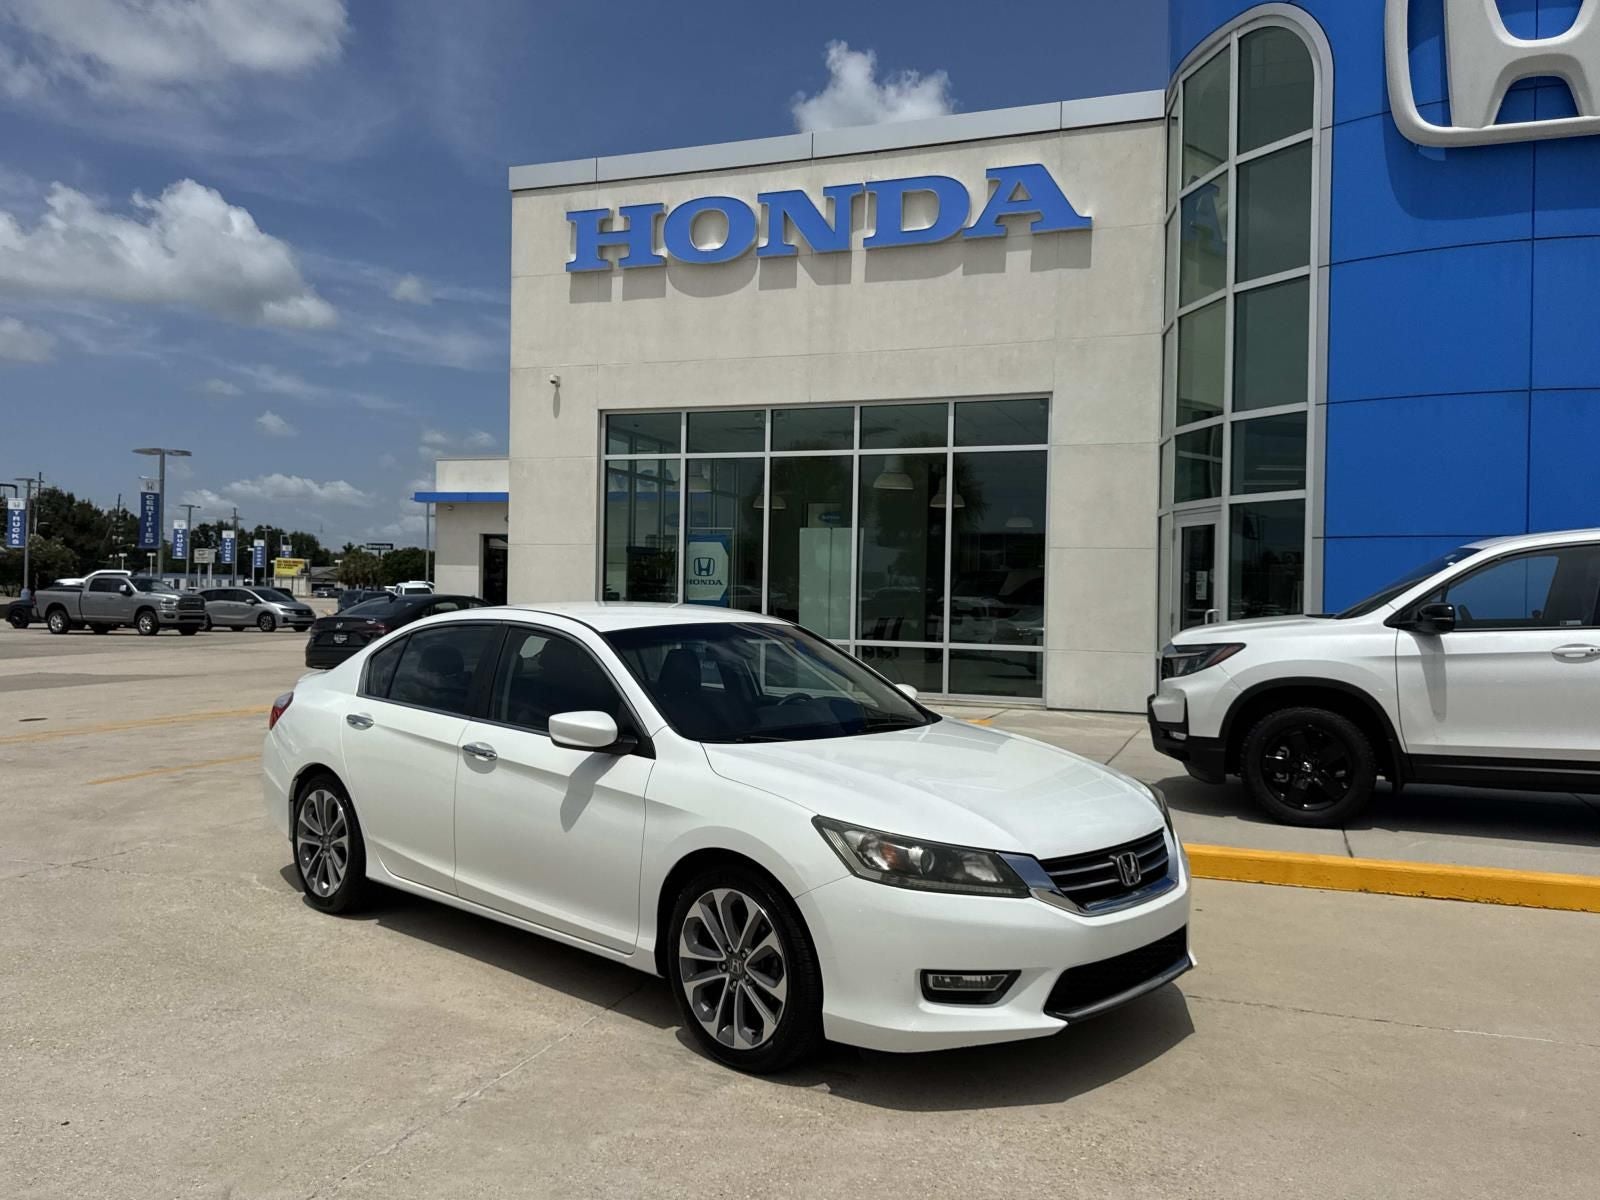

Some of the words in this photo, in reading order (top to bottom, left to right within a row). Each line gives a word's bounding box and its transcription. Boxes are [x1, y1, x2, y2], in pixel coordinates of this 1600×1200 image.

[566, 163, 1093, 272] HONDA
[11, 510, 21, 545] TRUCKS
[145, 494, 154, 544] CERTIFIED
